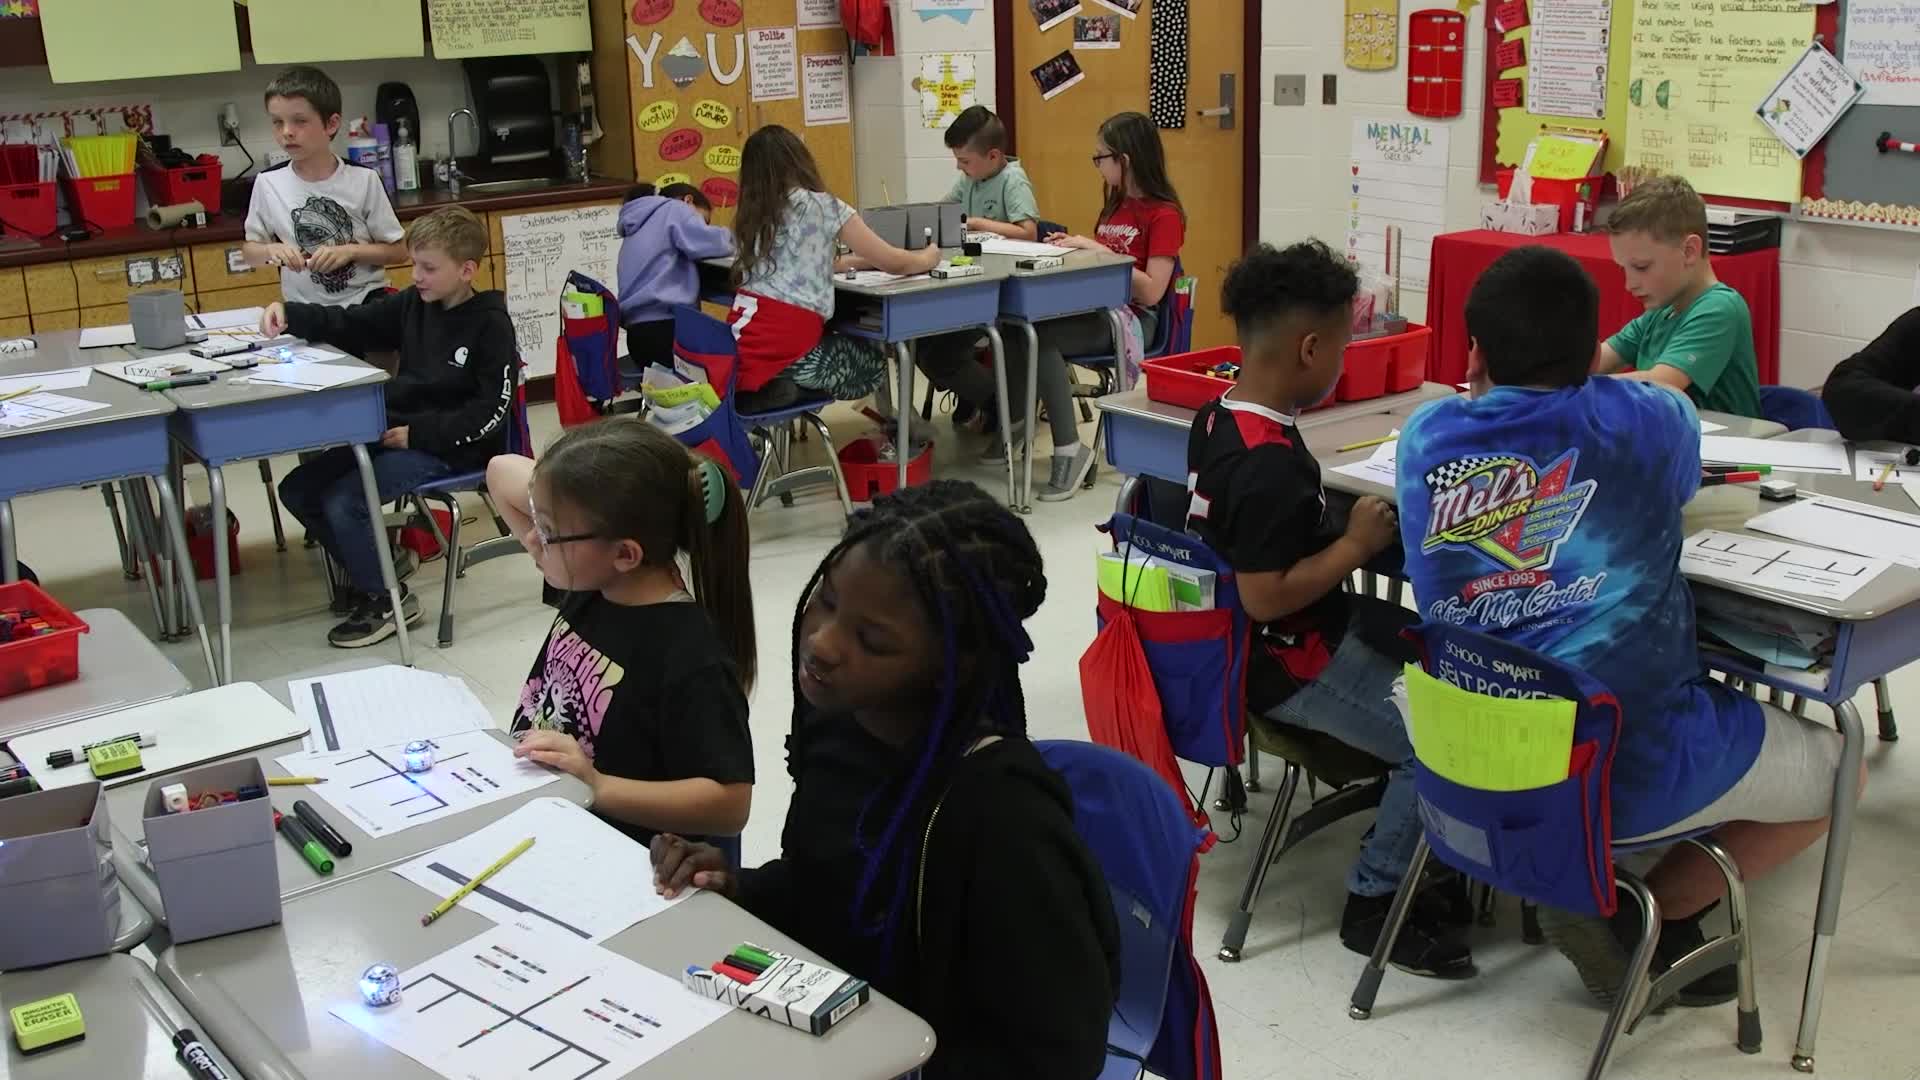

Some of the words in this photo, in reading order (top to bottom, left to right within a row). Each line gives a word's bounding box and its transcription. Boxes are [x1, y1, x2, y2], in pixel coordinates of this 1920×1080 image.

[758, 30, 785, 41] Polite
[625, 31, 745, 88] YU
[806, 56, 843, 68] Prepared
[945, 84, 959, 92] Can
[1367, 122, 1432, 145] MENTAL
[708, 153, 740, 167] SUCCEE
[520, 214, 570, 230] Subtraction
[1430, 462, 1535, 536] Mel's
[1472, 498, 1534, 533] DINER
[1471, 575, 1506, 595] SINCE
[1508, 571, 1536, 586] 1993
[1445, 640, 1488, 669] SCHOOL
[1492, 659, 1543, 682] SMART
[1476, 677, 1562, 702] POCK
[24, 1009, 73, 1027] ERASER
